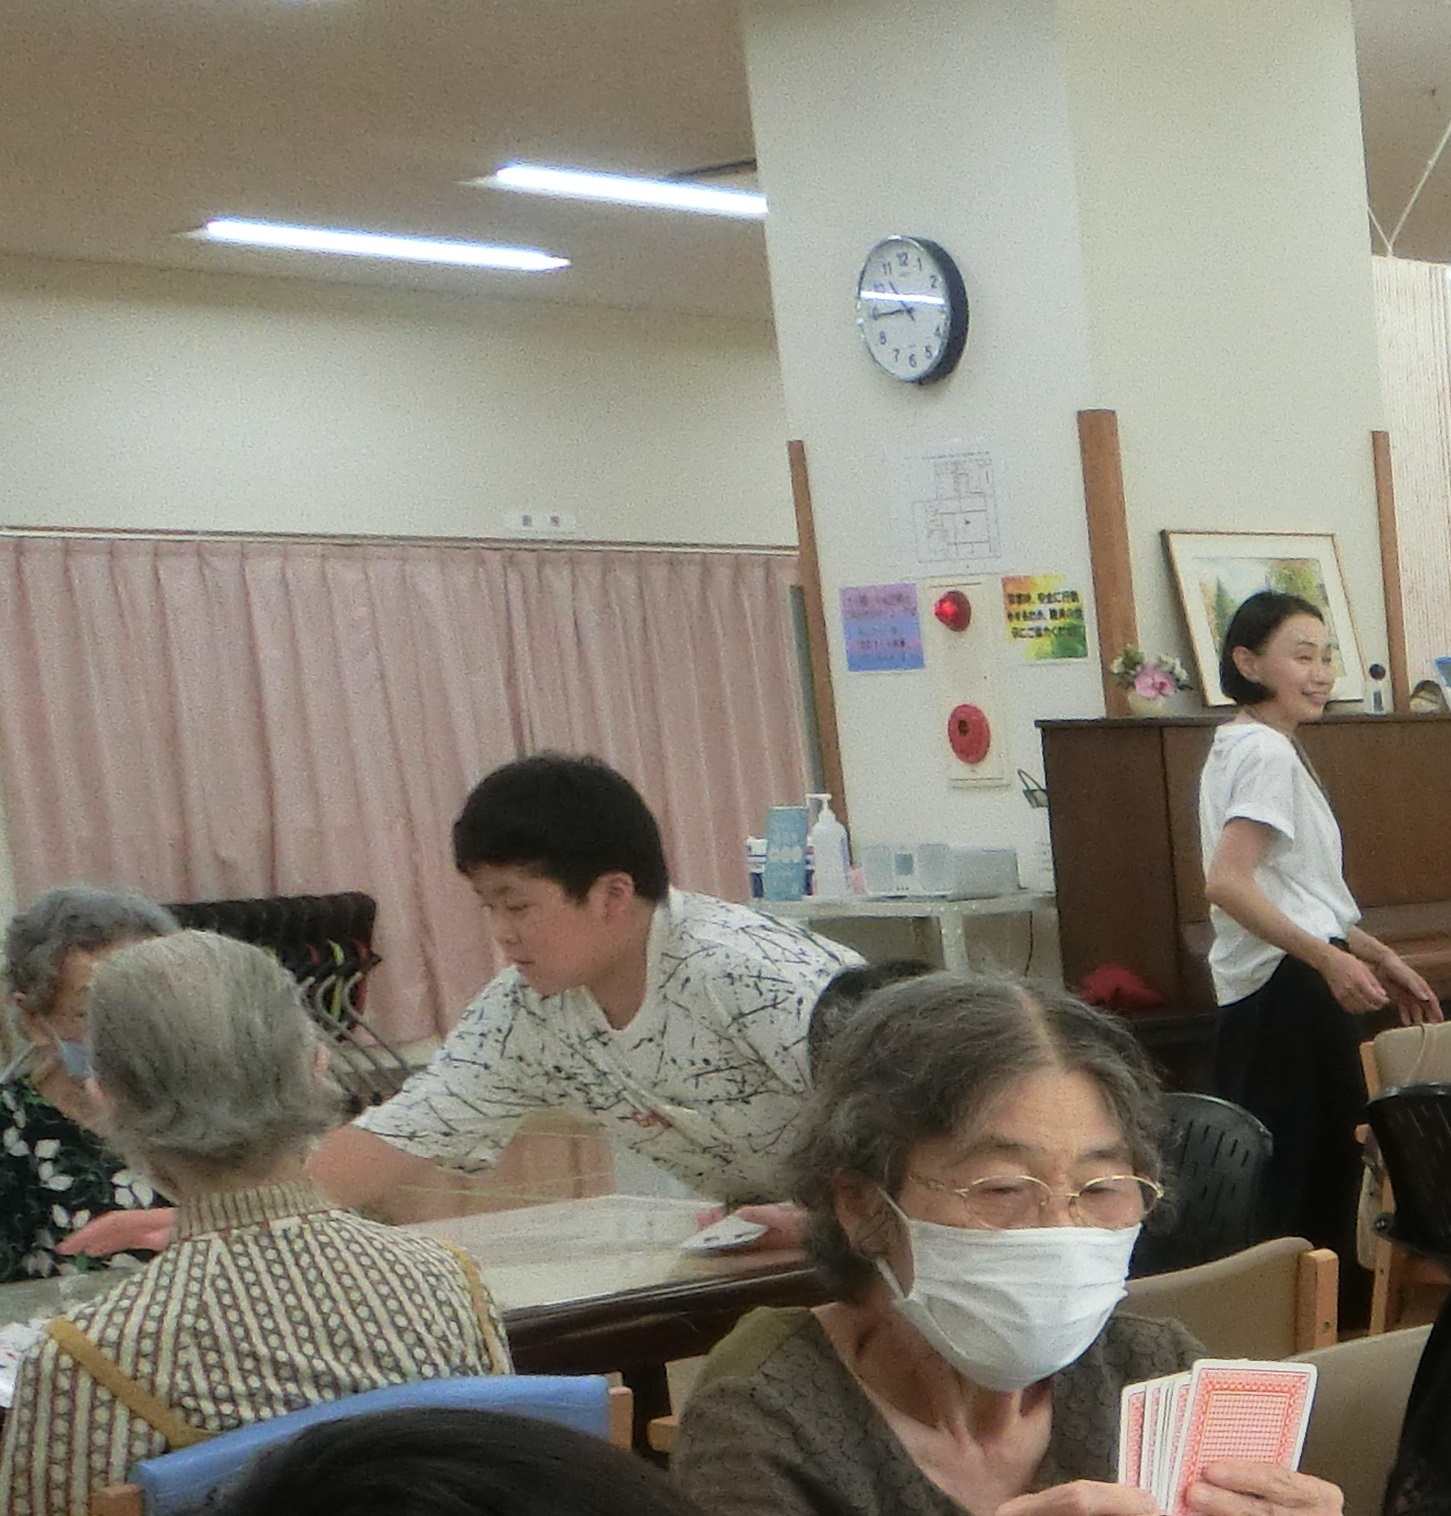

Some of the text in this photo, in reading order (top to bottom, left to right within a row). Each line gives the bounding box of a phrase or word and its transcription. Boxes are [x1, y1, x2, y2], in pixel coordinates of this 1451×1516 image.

[896, 252, 909, 266] 12
[882, 262, 892, 275] 11
[909, 353, 917, 368] 6
